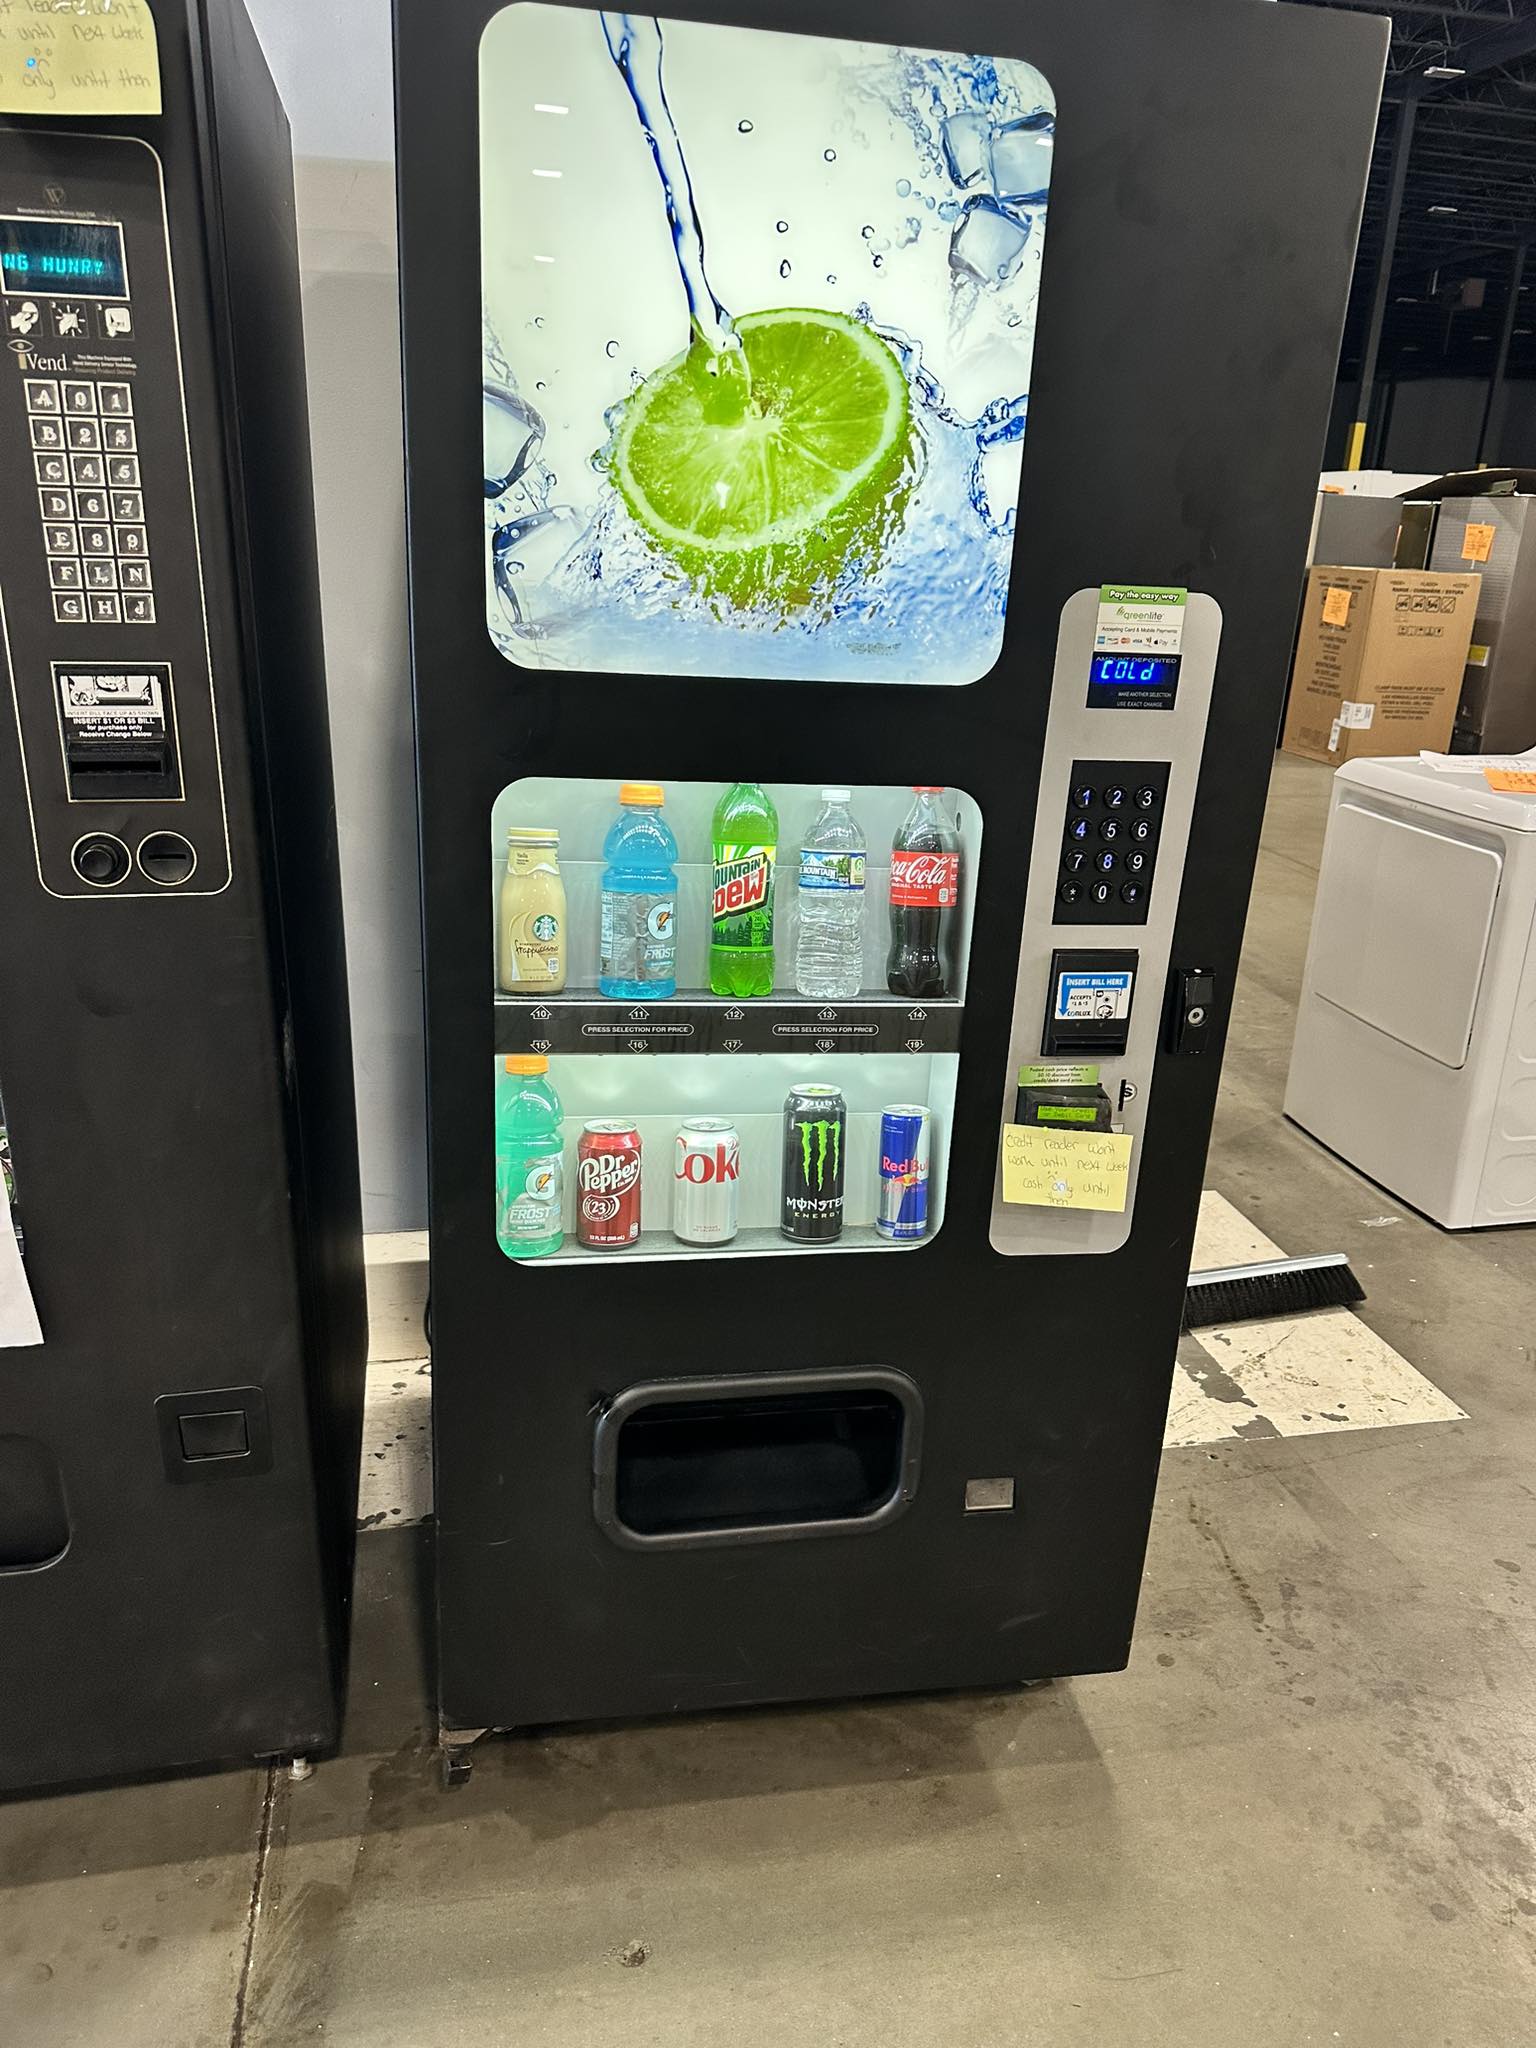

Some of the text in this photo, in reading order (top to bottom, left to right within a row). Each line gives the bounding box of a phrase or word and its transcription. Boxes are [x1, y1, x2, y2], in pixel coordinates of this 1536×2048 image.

[34, 389, 53, 407] A
[111, 393, 122, 409] 1
[41, 426, 127, 445] B 2 3
[45, 461, 62, 478] C
[51, 497, 133, 514] D 6 7
[54, 532, 138, 549] E 8 9
[60, 566, 74, 581] F
[128, 567, 143, 582] N
[1110, 590, 1179, 602] Pay the easy way
[63, 600, 145, 615] G H J
[106, 731, 131, 739] Change
[1083, 790, 1152, 806] 1 2 3
[1076, 822, 1148, 838] 4 5 6
[1074, 854, 1142, 870] 7 8 9
[1098, 885, 1107, 900] 0
[644, 947, 676, 960] FROST
[1067, 977, 1124, 986] INSERT BILL HERE
[823, 1011, 833, 1019] 13
[633, 1041, 643, 1049] 16
[599, 1155, 625, 1175] Dr
[883, 1155, 909, 1173] Red
[526, 1164, 555, 1200] G
[580, 1157, 638, 1194] Pepper
[510, 1206, 551, 1220] FROST
[591, 1201, 606, 1215] 23
[794, 1211, 840, 1219] ENERGY
